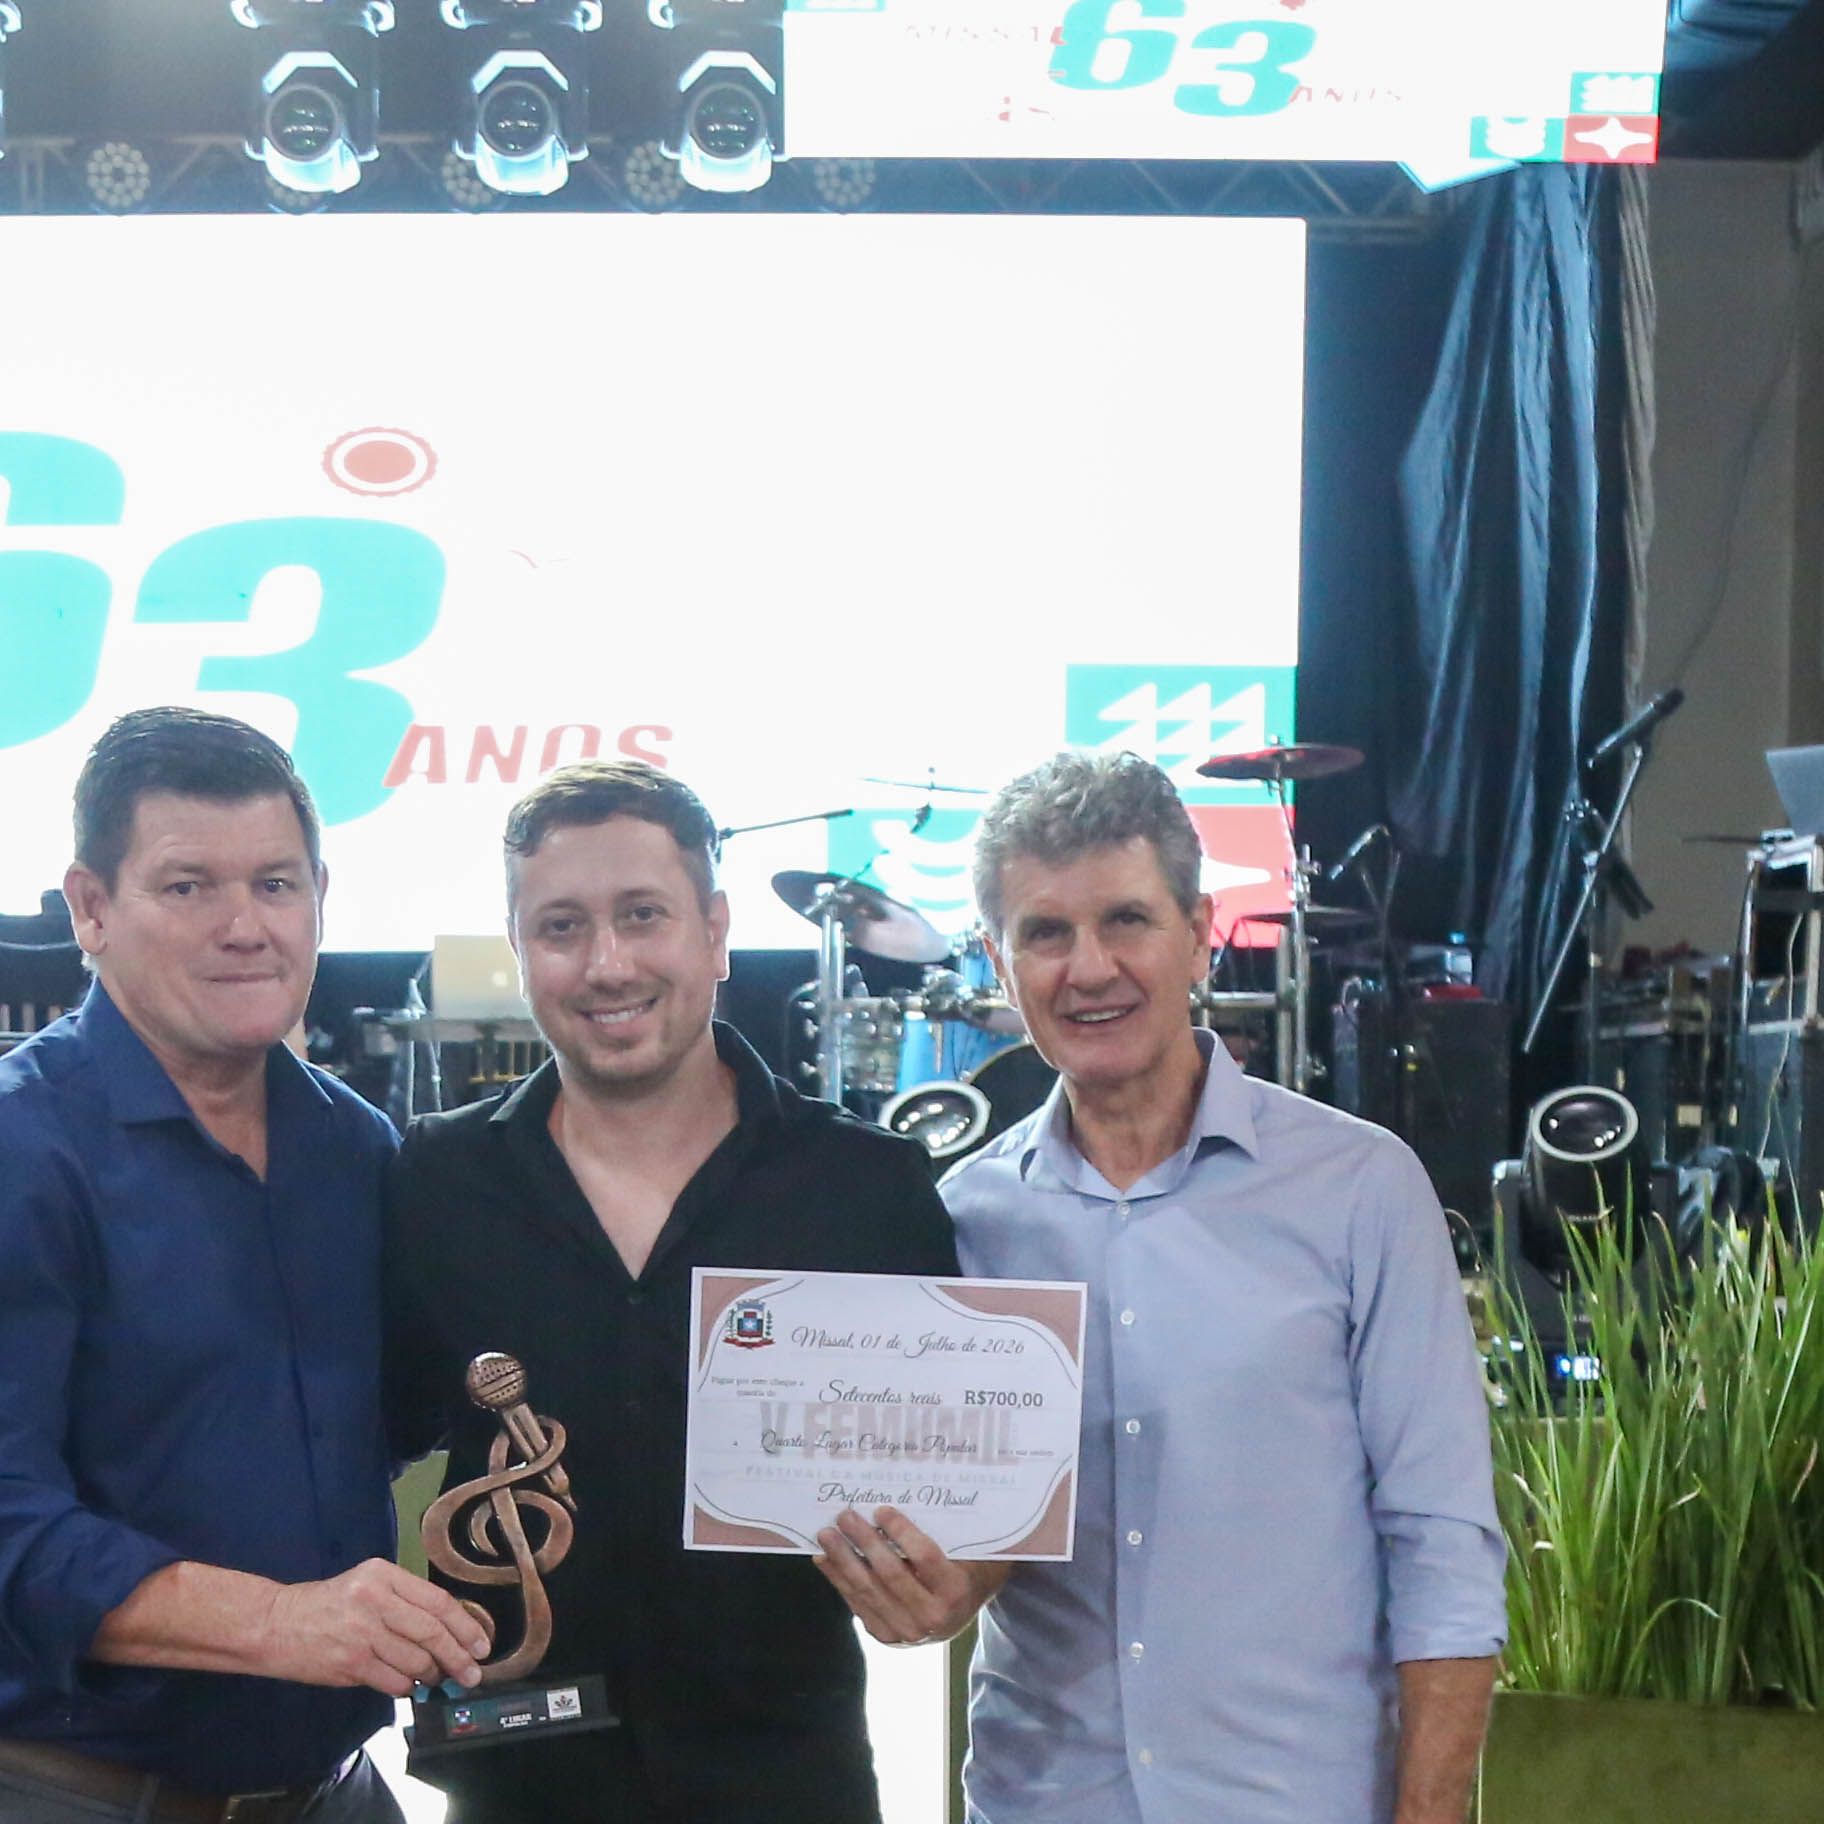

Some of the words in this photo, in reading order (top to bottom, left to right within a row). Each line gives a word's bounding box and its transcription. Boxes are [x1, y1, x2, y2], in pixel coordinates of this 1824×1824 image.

[1048, 0, 1318, 117] 63
[383, 723, 675, 787] ANOS
[886, 1334, 903, 1350] de
[903, 1328, 956, 1359] Julho
[961, 1338, 977, 1353] de
[819, 1379, 903, 1404] Setecentos
[910, 1393, 944, 1405] reais
[964, 1389, 1044, 1409] R$700,00
[816, 1482, 893, 1512] Prefeitura
[898, 1488, 913, 1504] de
[917, 1485, 979, 1506] Missal
